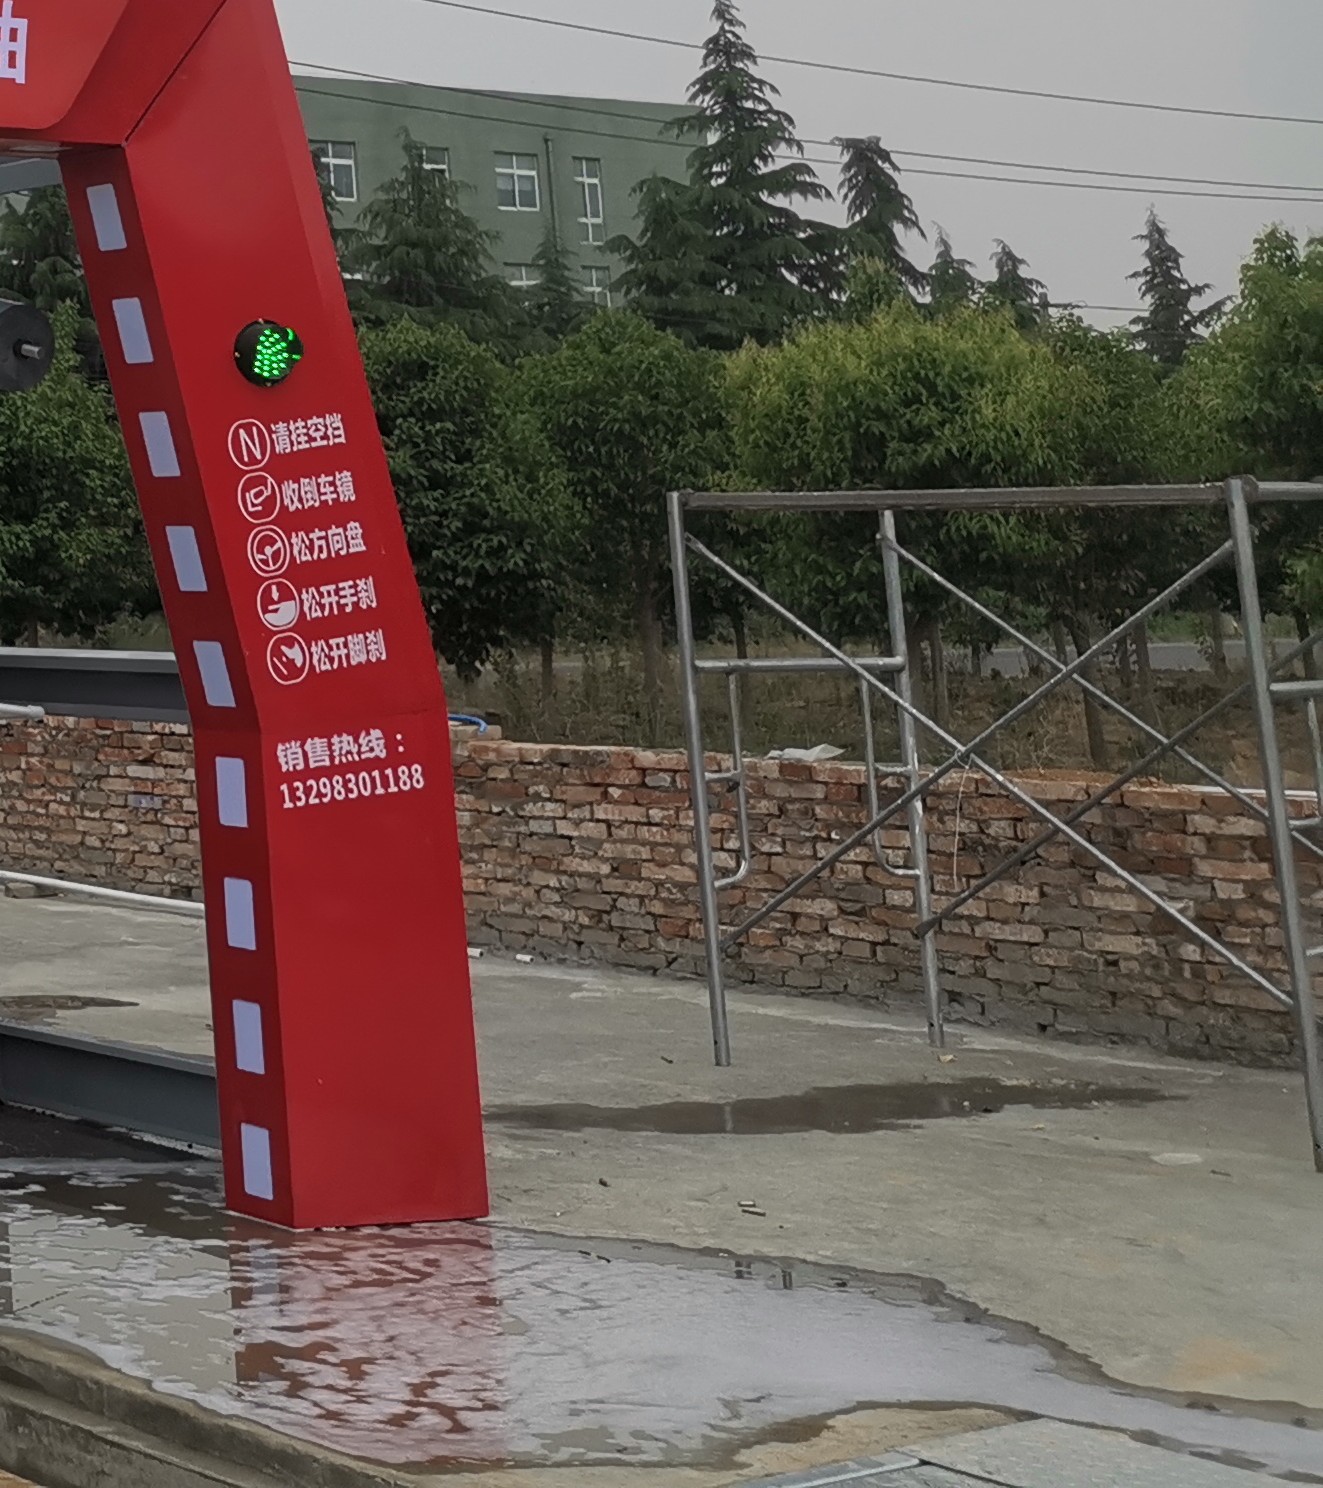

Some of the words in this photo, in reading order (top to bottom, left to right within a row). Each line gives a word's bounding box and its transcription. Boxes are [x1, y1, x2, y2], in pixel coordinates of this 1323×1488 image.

[270, 413, 346, 454] 请挂空挡
[281, 470, 356, 512] 收倒车镜
[291, 521, 367, 564] 松方向盘
[301, 575, 377, 621] 松开手刹
[311, 628, 387, 673] 松开脚刹
[280, 763, 425, 809] 13298301188
